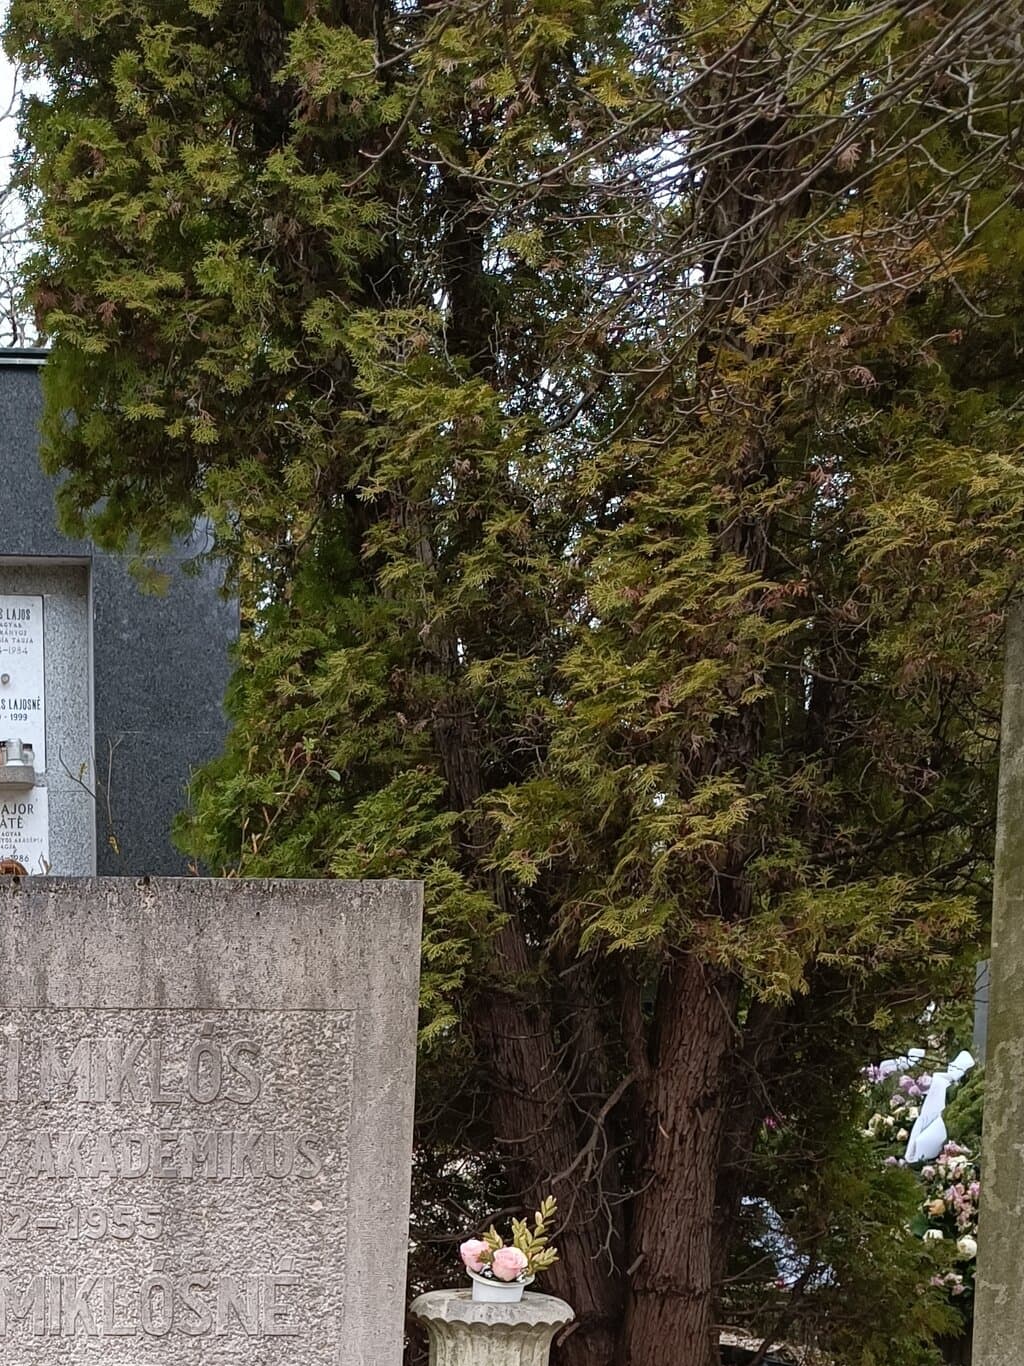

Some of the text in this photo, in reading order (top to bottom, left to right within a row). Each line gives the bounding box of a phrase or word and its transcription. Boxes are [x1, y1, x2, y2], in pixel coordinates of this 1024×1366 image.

[6, 608, 31, 621] LAJOS
[12, 637, 34, 645] TAGJA
[8, 695, 41, 711] LAJOSNÉ
[10, 712, 28, 721] 1999
[39, 1021, 262, 1104] MIKLÓS
[26, 1113, 323, 1180] AKADÉMIKUS
